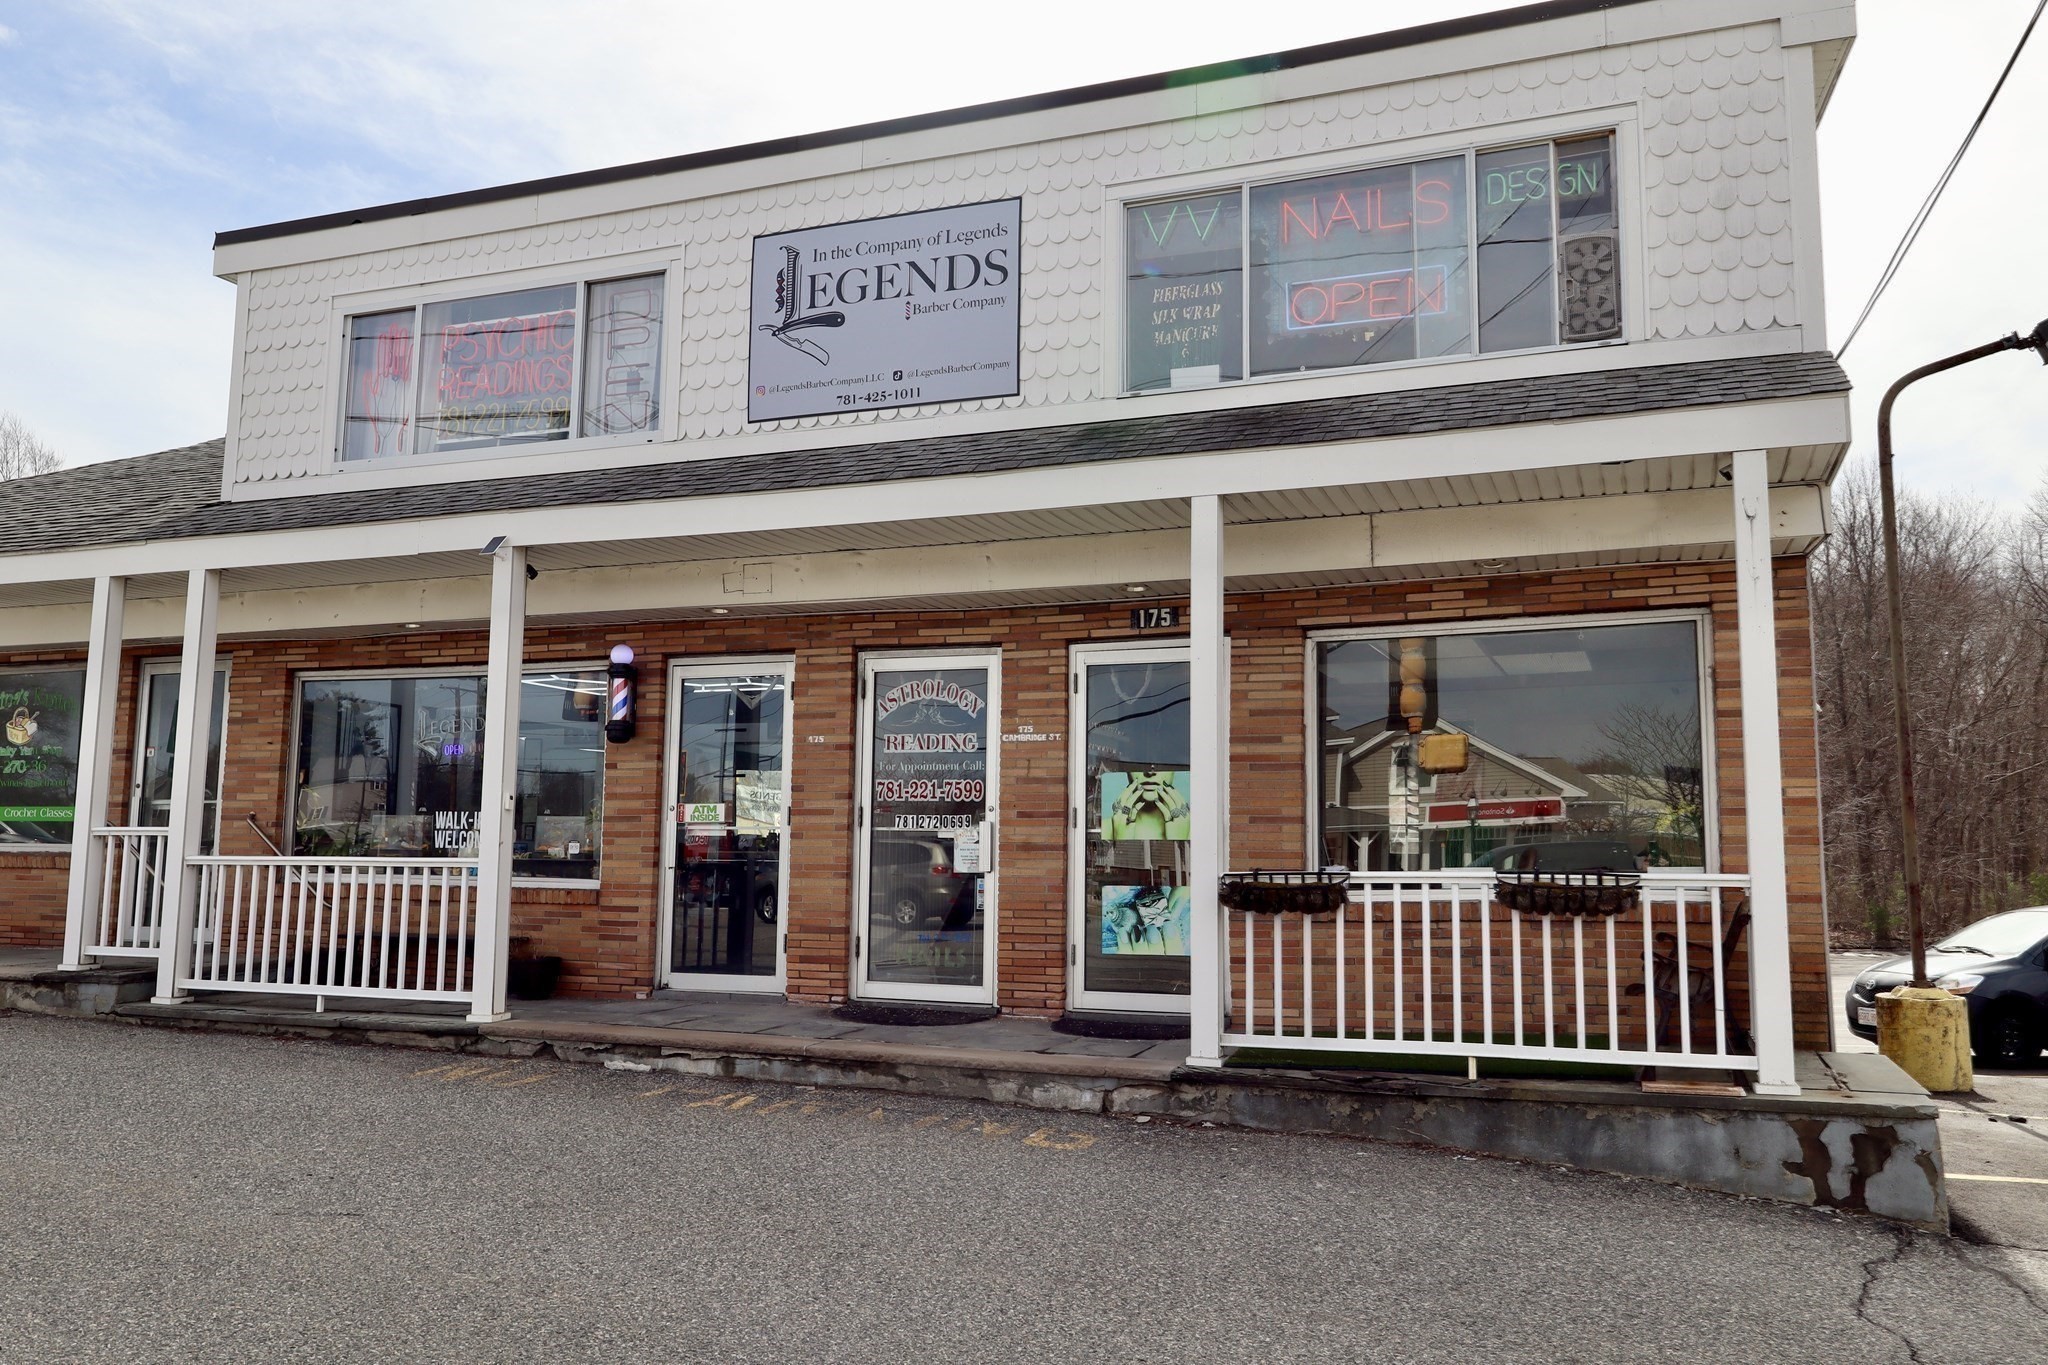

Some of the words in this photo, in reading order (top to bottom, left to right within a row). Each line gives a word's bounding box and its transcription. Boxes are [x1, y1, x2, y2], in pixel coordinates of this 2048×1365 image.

[1281, 179, 1451, 245] NAILS
[1486, 162, 1598, 206] DESIGN
[812, 248, 827, 263] In
[831, 245, 852, 261] the
[856, 236, 924, 258] Company
[927, 230, 943, 246] of
[946, 223, 1008, 247] Legends
[912, 300, 951, 316] Barber
[953, 295, 1008, 314] Company
[1291, 272, 1444, 325] OPEN
[442, 310, 576, 364] PSYCHIC
[437, 354, 573, 402] READINGS
[907, 360, 1011, 379] @LegendsBarberCompany
[769, 372, 885, 394] @LegendsBarberCompanyLLC
[836, 386, 921, 406] 781-425-1011
[1138, 607, 1172, 628] 175
[877, 678, 986, 721] ASTROLOGY
[1002, 734, 1047, 742] CAMBRIDGE
[1048, 733, 1062, 741] ST.
[1017, 725, 1034, 733] 175
[444, 743, 464, 756] OPEN
[883, 732, 979, 754] READING
[880, 762, 896, 771] For
[898, 761, 960, 774] Appointment
[962, 760, 985, 771] Call:
[875, 779, 984, 803] 781-221-7599
[4, 807, 37, 818] Crochet
[40, 807, 73, 818] Classes
[690, 814, 720, 822] INSIDE
[692, 805, 717, 814] ATM
